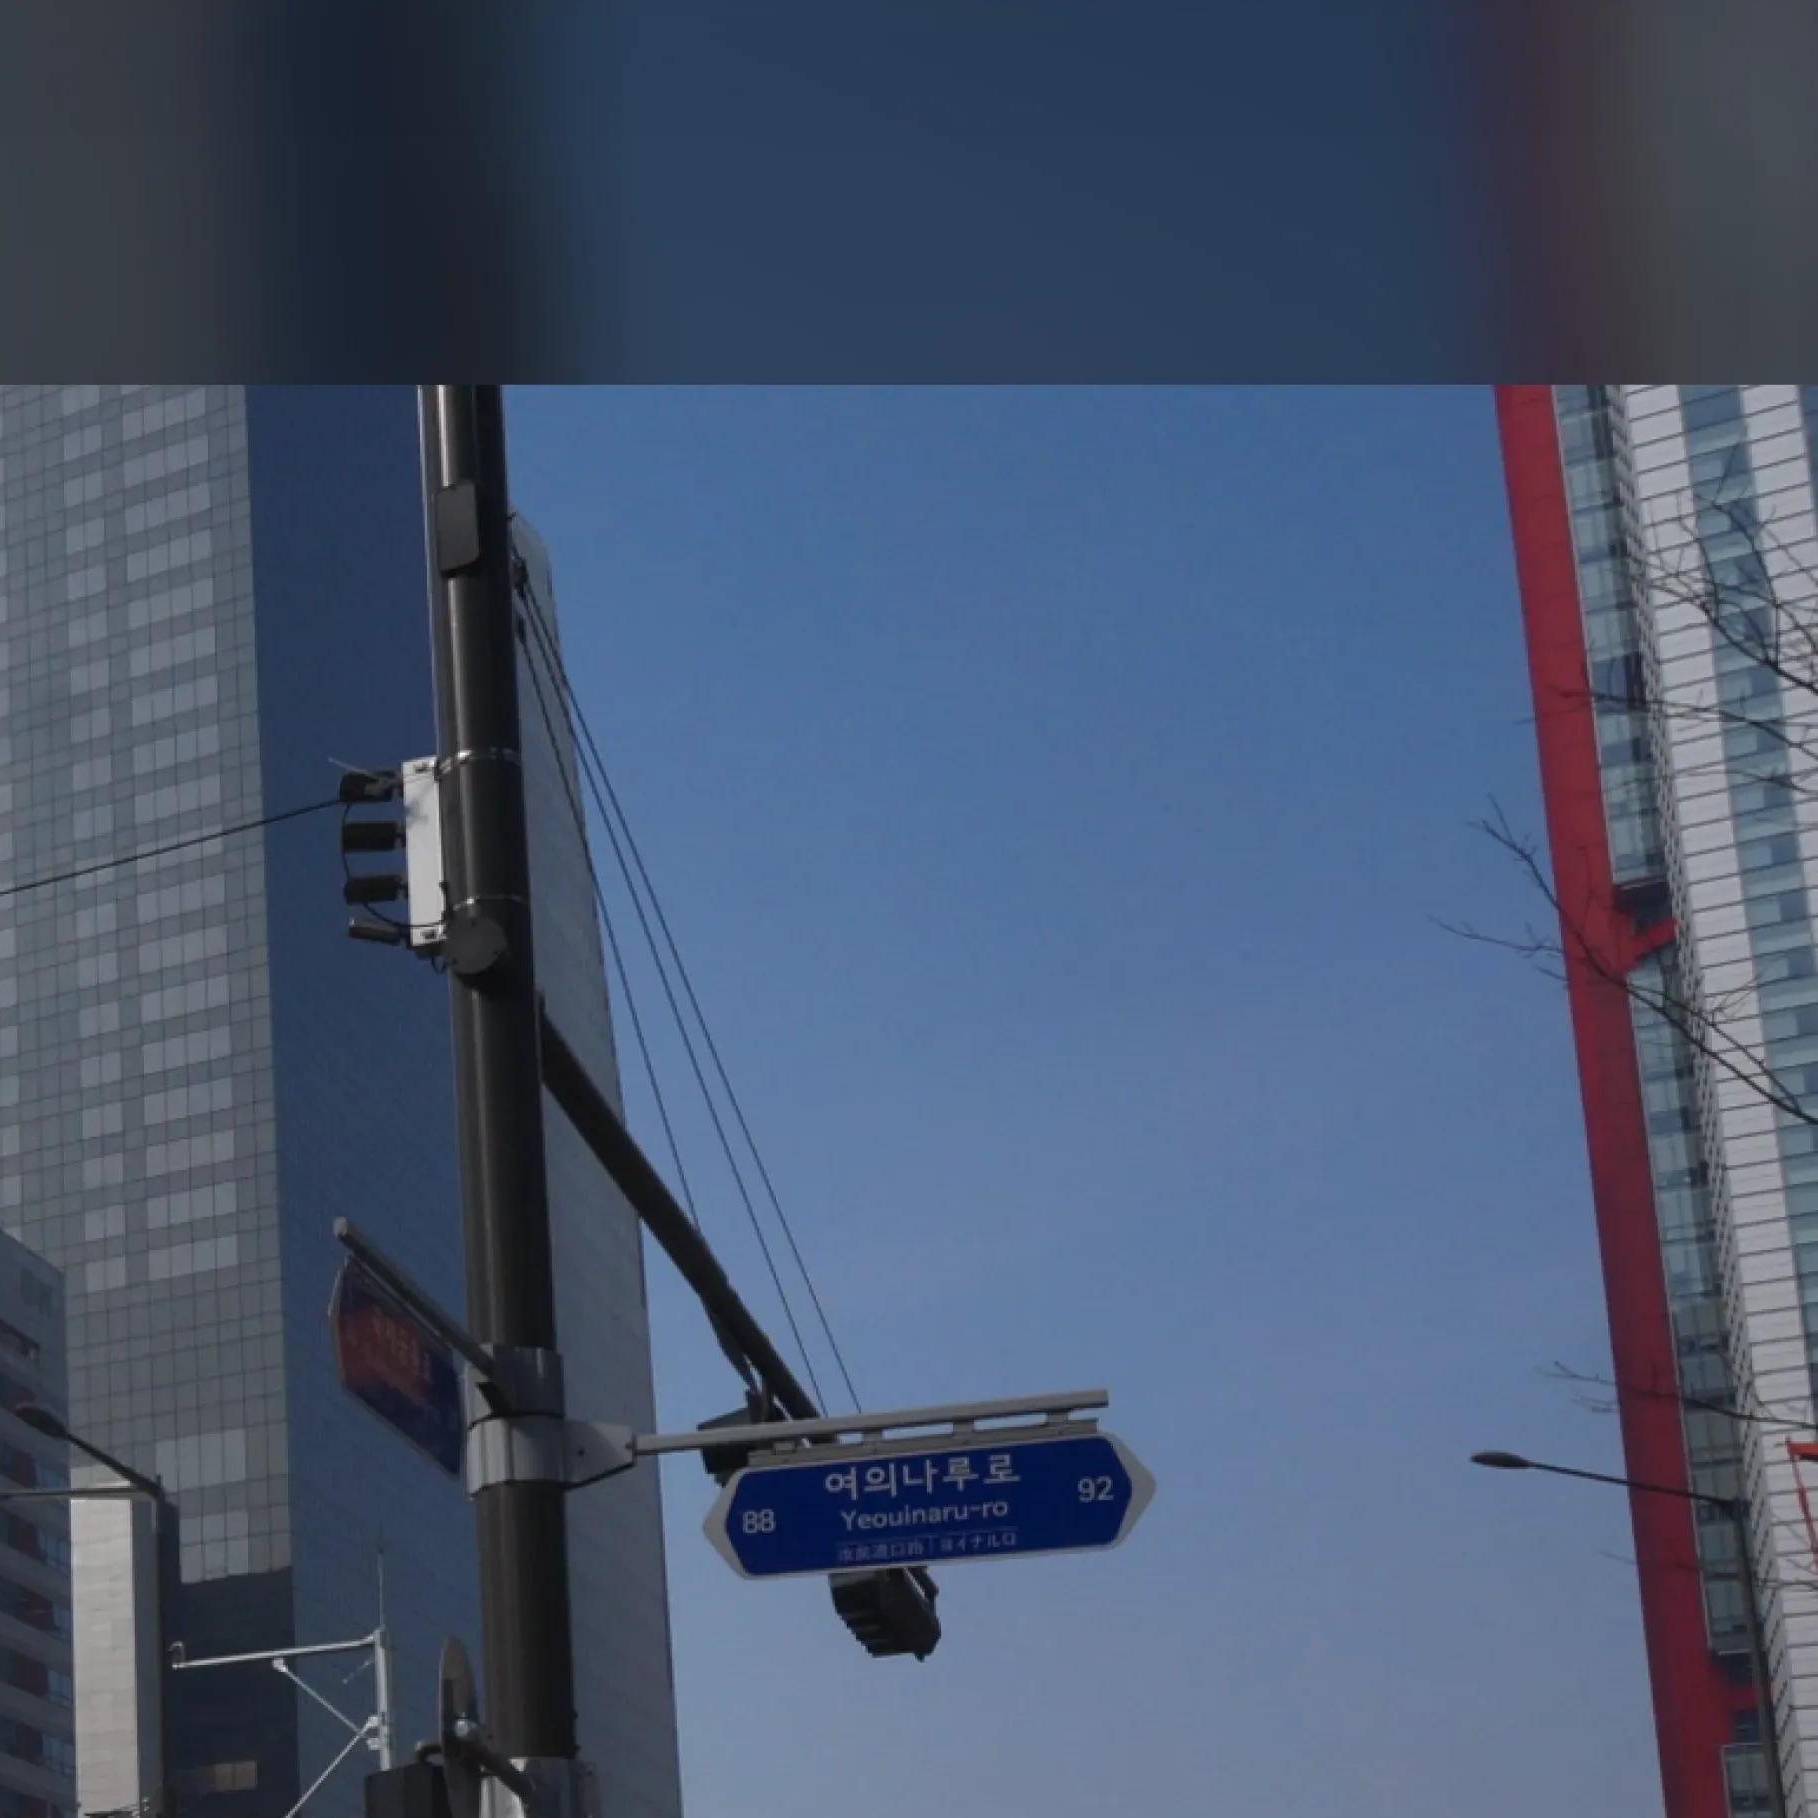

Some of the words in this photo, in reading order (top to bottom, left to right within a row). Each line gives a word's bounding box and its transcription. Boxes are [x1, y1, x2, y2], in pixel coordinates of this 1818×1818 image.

[823, 1454, 1021, 1501] 여의나루로
[1077, 1475, 1114, 1504] 92
[742, 1509, 776, 1535] 88
[840, 1500, 1008, 1532] Yeouinaru-ro
